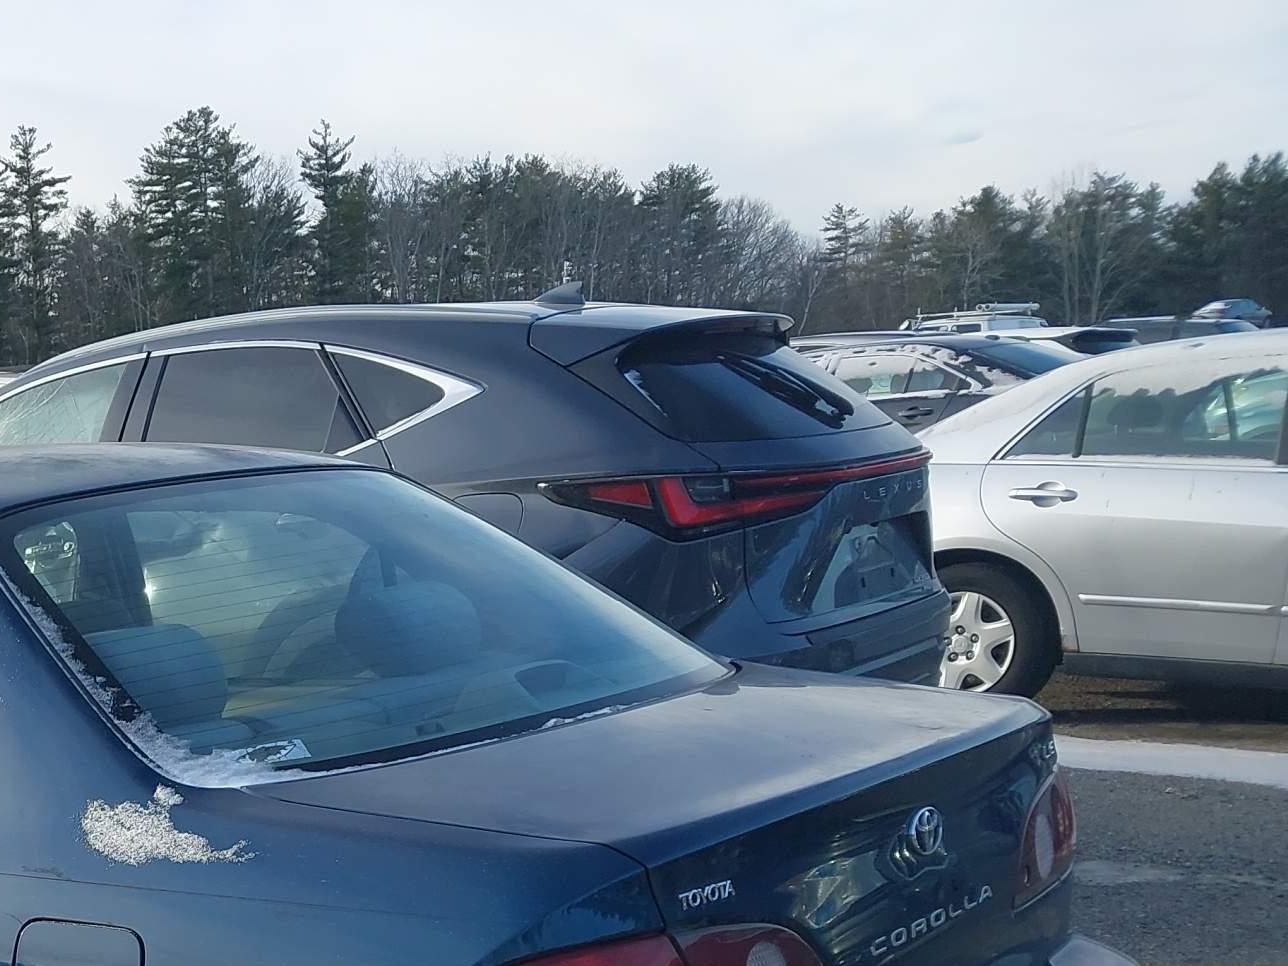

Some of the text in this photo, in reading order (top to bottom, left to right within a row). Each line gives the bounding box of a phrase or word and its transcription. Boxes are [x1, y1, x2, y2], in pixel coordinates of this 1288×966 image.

[863, 479, 922, 500] LEXUS
[678, 879, 736, 911] TOYOTA
[870, 885, 993, 956] COROLLA
